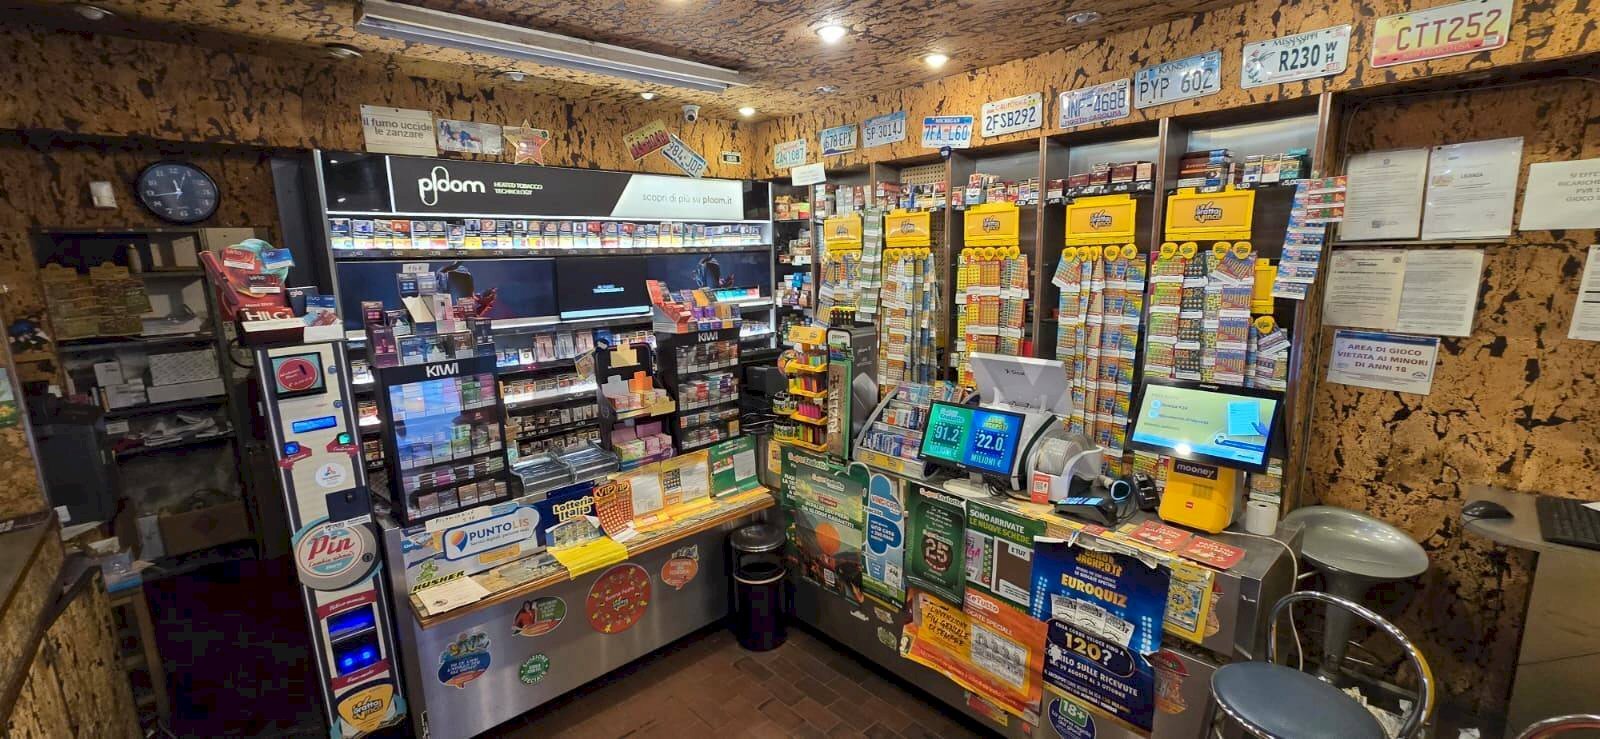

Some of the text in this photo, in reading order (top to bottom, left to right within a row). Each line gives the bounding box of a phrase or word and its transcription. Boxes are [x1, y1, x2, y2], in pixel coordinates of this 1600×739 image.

[1397, 9, 1501, 50] CTT252
[1279, 44, 1321, 72] R230
[1158, 62, 1193, 73] KANSA
[1140, 69, 1213, 102] PYP 602
[363, 116, 432, 132] il fumo uccide
[985, 107, 1036, 131] 2FSB292
[374, 127, 424, 139] le zanzare
[418, 166, 486, 206] ploom
[642, 192, 667, 204] scopri
[669, 192, 677, 203] di
[702, 194, 732, 207] ploom.it
[698, 330, 718, 343] KIWI
[1337, 350, 1429, 367] VIETATA AI MINORI
[1347, 343, 1422, 357] AREA DI GIOCO
[426, 362, 460, 378] KIWI
[1354, 360, 1407, 373] DI ANNI 18
[935, 426, 960, 442] 91.2
[976, 433, 1004, 450] 22.0
[1176, 464, 1215, 479] mooney
[596, 484, 616, 497] VIP
[553, 496, 594, 514] Lotteria
[559, 504, 592, 521] Italia
[969, 509, 990, 521] SONO
[990, 514, 1025, 534] ARRIVATE
[307, 534, 354, 561] Pin
[925, 538, 949, 563] 25
[1061, 573, 1128, 608] EUROQUIZ
[1076, 657, 1098, 677] SULLE
[1100, 670, 1139, 697] RICEVUTE
[1061, 699, 1086, 719] 18+
